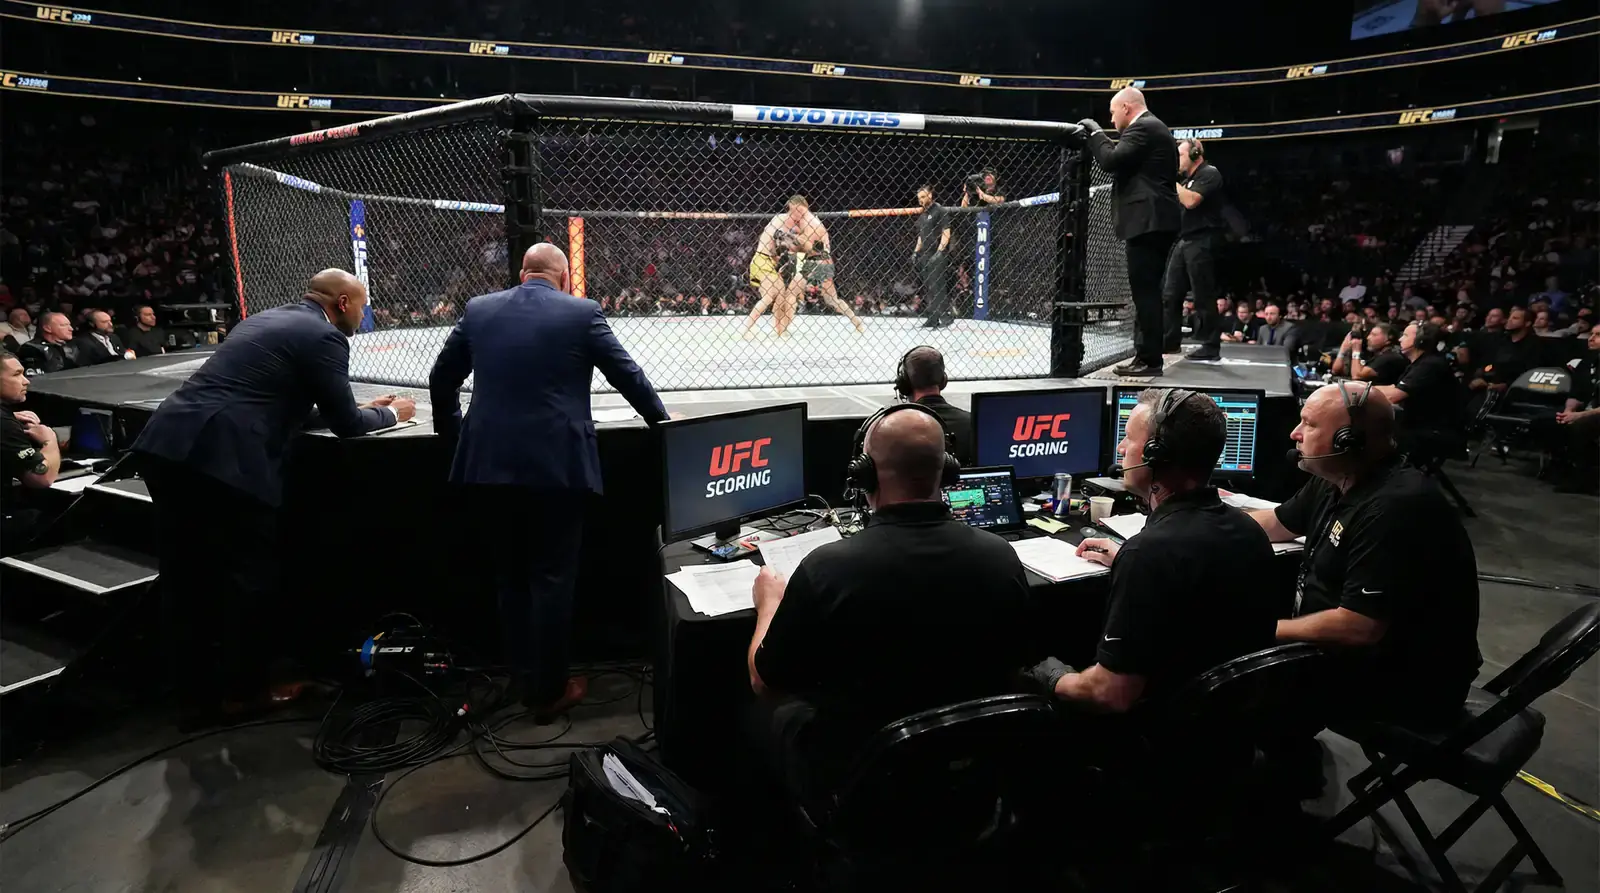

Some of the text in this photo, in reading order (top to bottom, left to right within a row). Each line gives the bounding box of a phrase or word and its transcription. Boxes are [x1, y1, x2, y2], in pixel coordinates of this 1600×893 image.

[36, 7, 73, 22] UFC
[271, 31, 300, 44] UFC
[1501, 31, 1539, 49] UFC
[469, 42, 496, 54] UFC
[647, 52, 673, 65] UFC
[811, 63, 836, 75] UFC
[1286, 65, 1314, 79] UFC
[959, 74, 981, 86] UFC
[277, 95, 310, 108] UFC
[755, 106, 901, 128] TOYO TIRES
[1398, 109, 1433, 124] UFC
[1528, 371, 1566, 385] UFC
[1012, 413, 1071, 441] UFC
[1008, 440, 1069, 458] SCORING
[709, 437, 772, 477] UFC
[705, 469, 771, 498] SCORING
